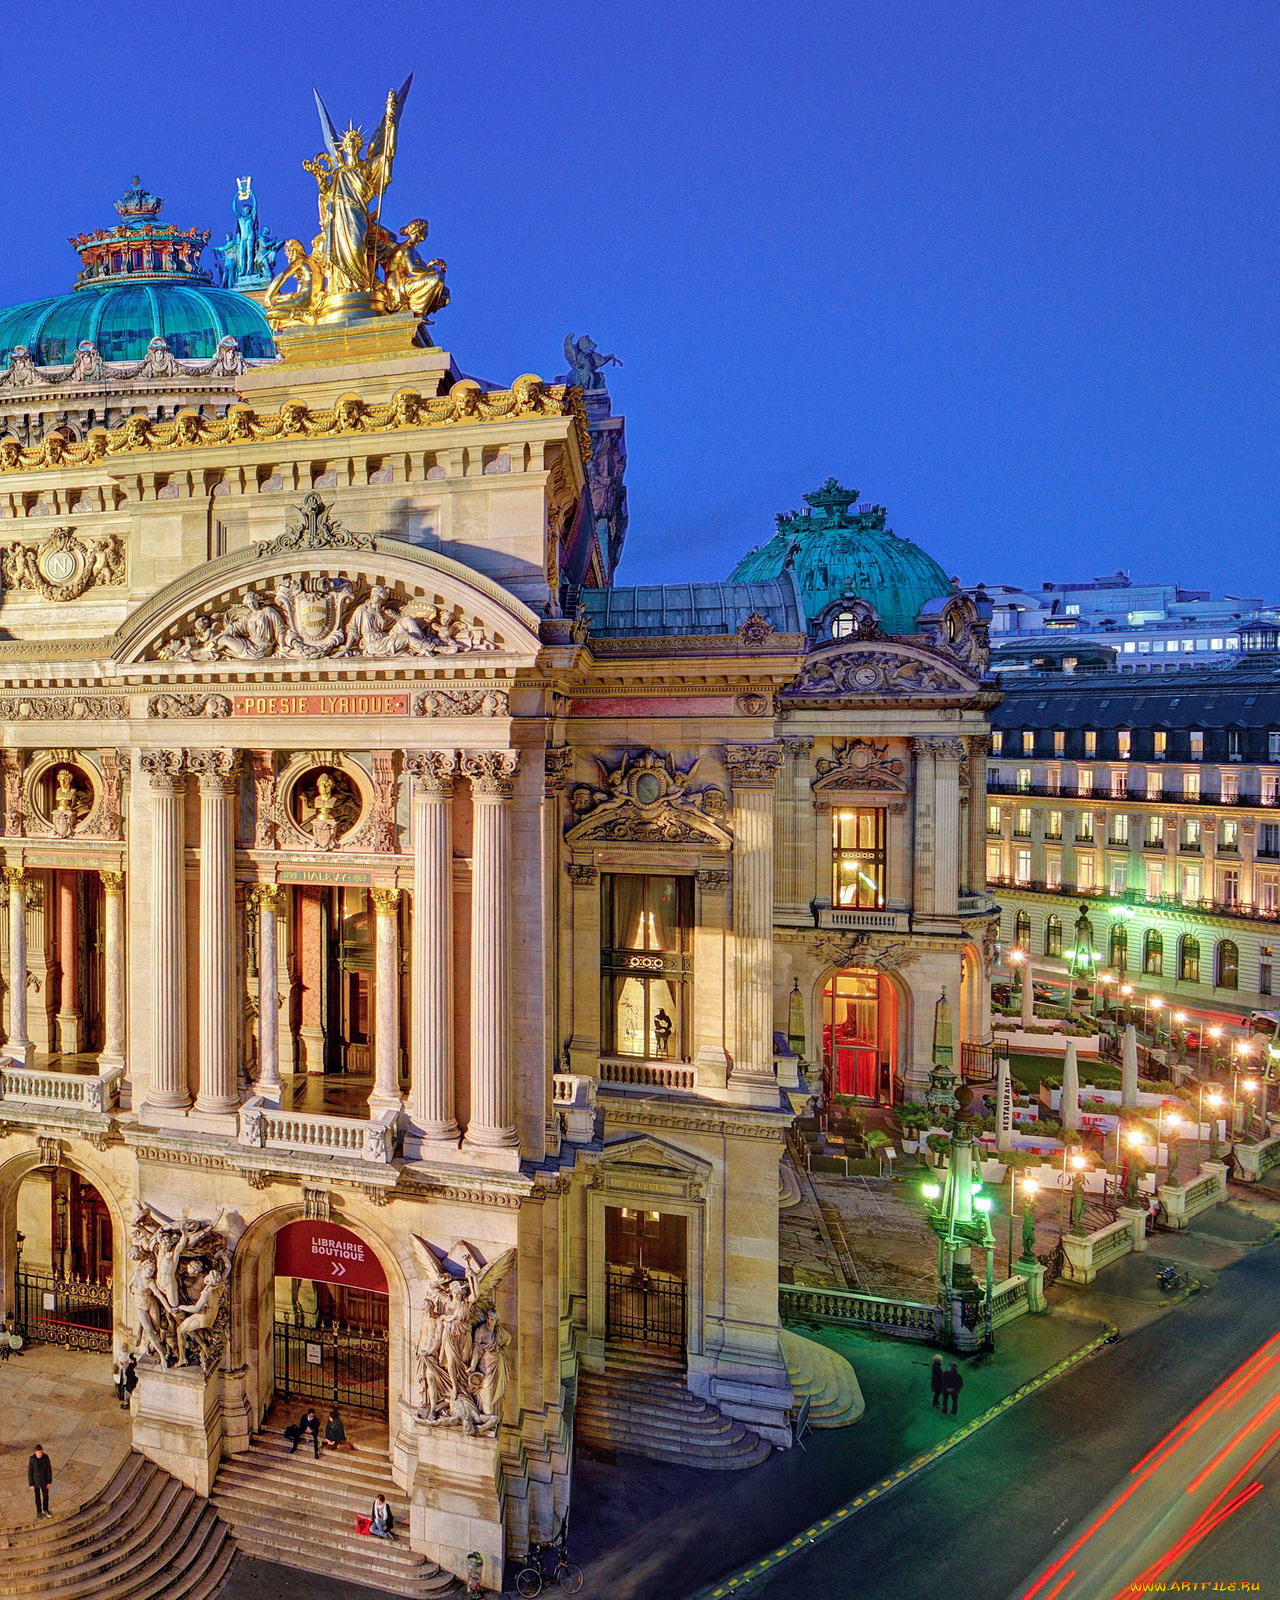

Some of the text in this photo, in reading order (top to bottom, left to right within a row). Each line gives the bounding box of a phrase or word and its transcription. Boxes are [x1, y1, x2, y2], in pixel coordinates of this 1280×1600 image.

[54, 557, 67, 573] N
[245, 697, 394, 715] POESIE LYRIQUE
[1003, 1077, 1011, 1131] RESTAURANT
[312, 1237, 364, 1253] LIBRAIRIE
[312, 1245, 364, 1262] BOUTIQUE
